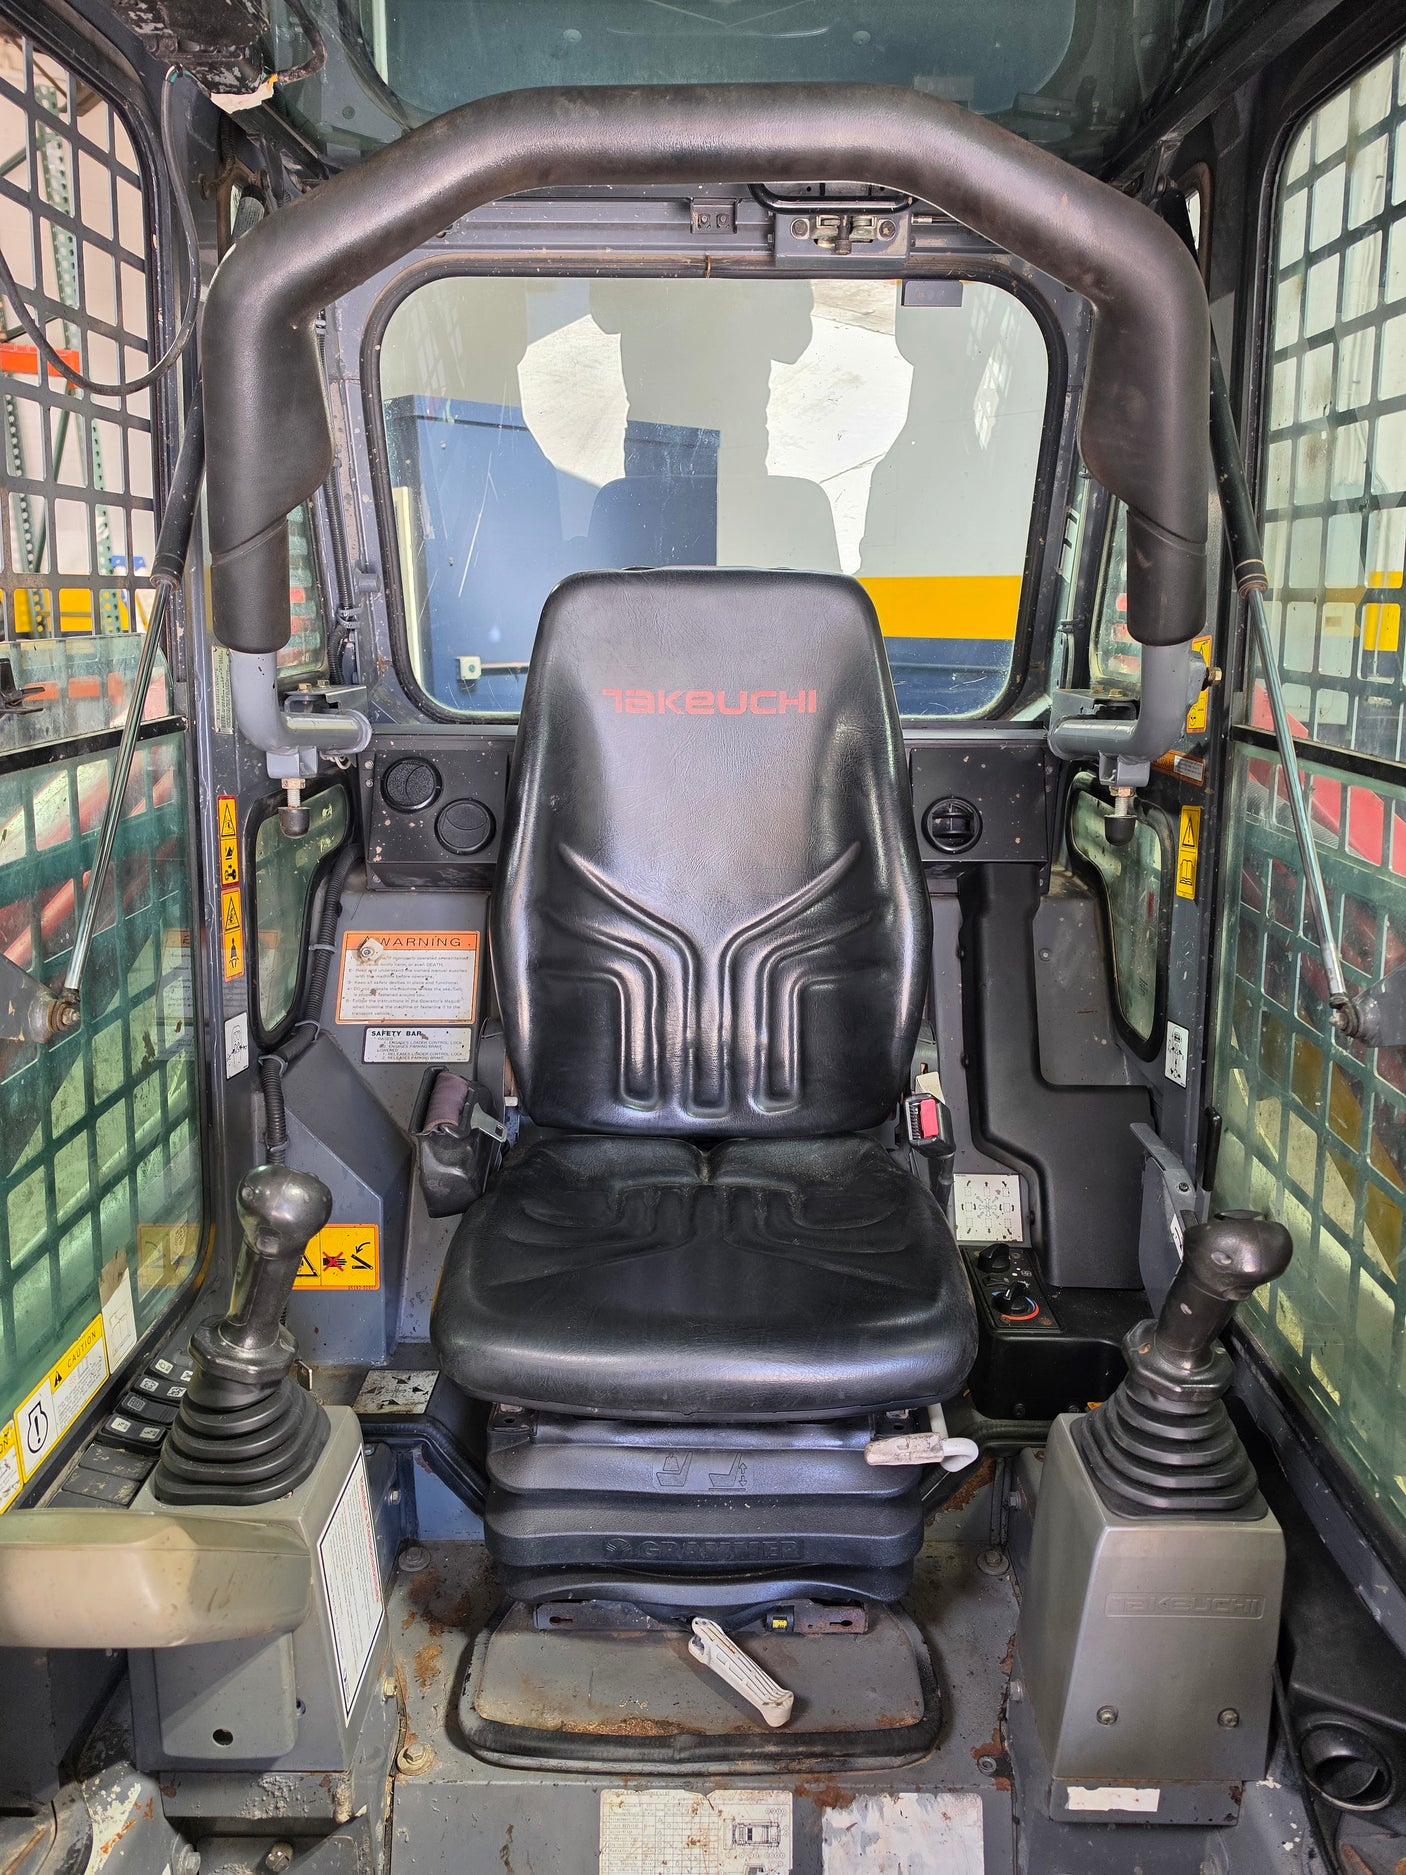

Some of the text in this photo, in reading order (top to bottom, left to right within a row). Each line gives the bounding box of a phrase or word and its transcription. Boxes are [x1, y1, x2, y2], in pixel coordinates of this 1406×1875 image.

[602, 689, 817, 715] TAKEUCHI
[380, 937, 461, 947] WARNING
[67, 1330, 97, 1368] CAUTION
